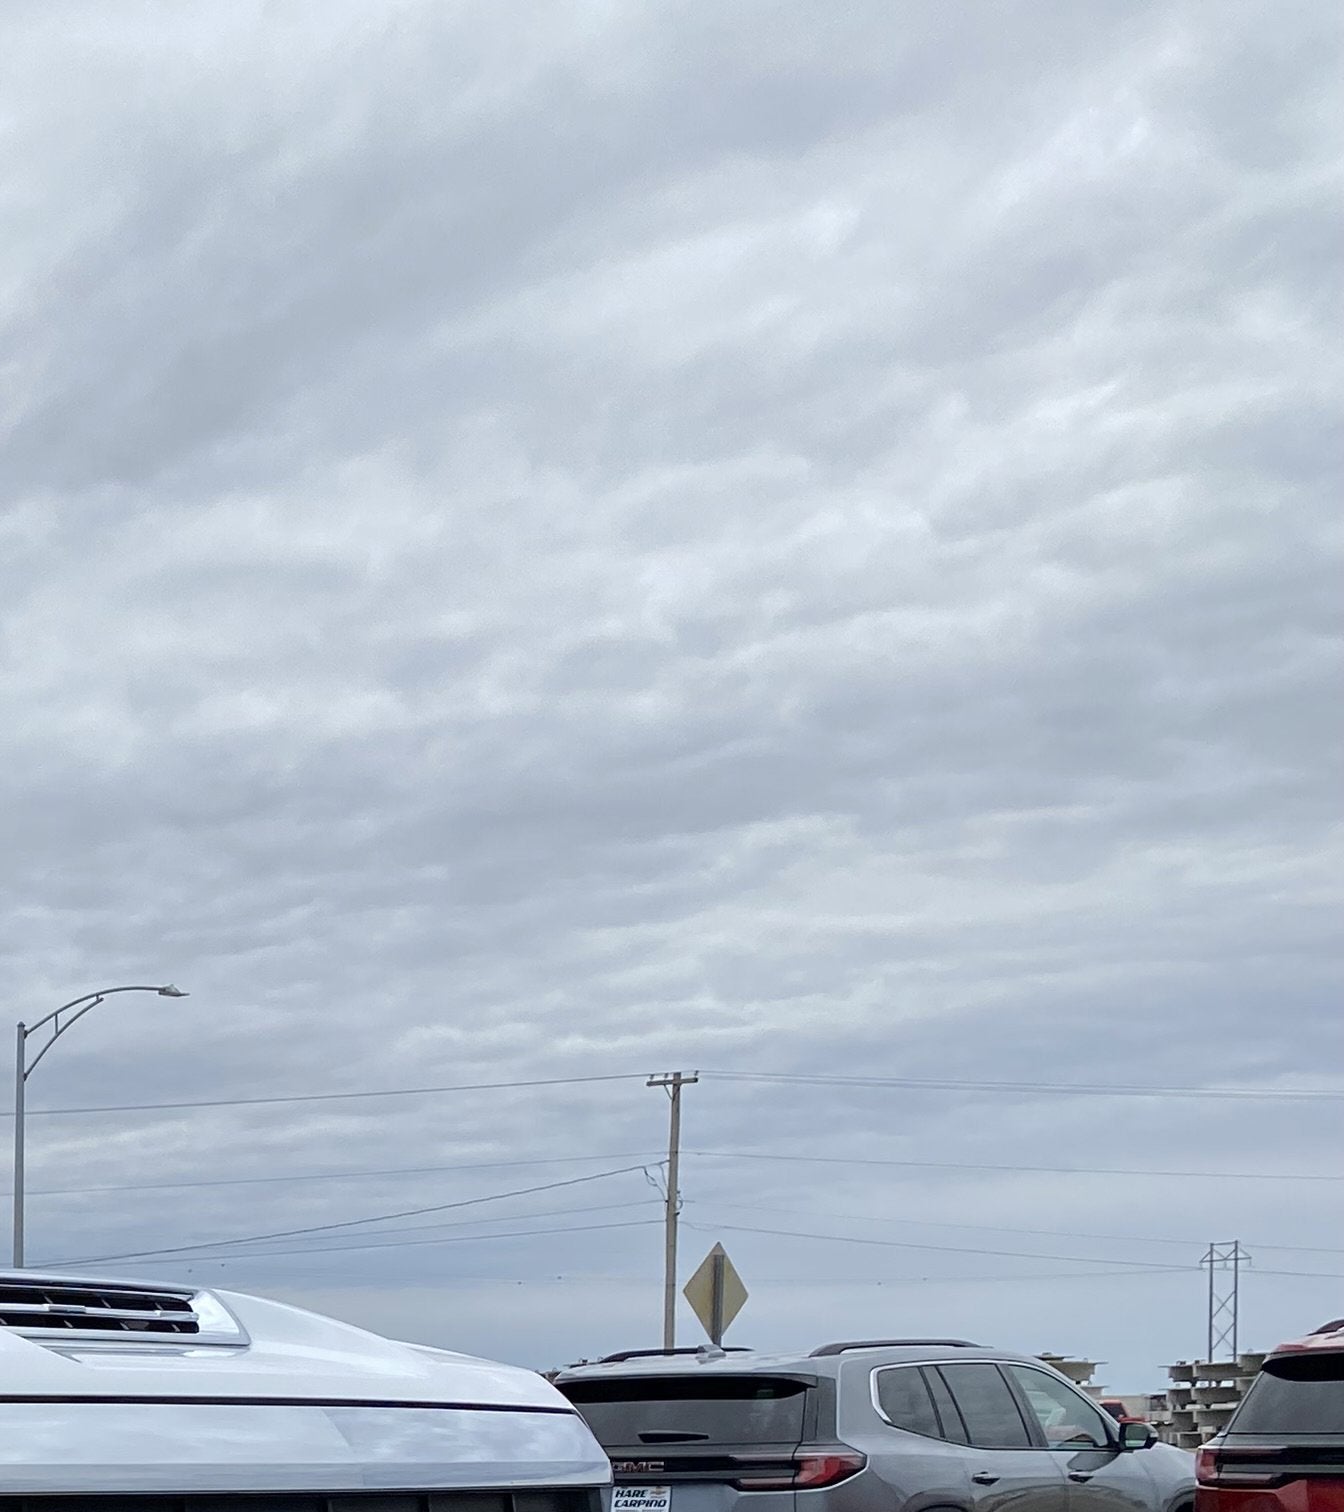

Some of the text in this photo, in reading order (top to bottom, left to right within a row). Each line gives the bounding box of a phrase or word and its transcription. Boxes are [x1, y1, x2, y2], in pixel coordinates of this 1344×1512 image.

[612, 1461, 664, 1472] GMC
[615, 1489, 648, 1498] HARE
[614, 1499, 667, 1508] CARPINO
